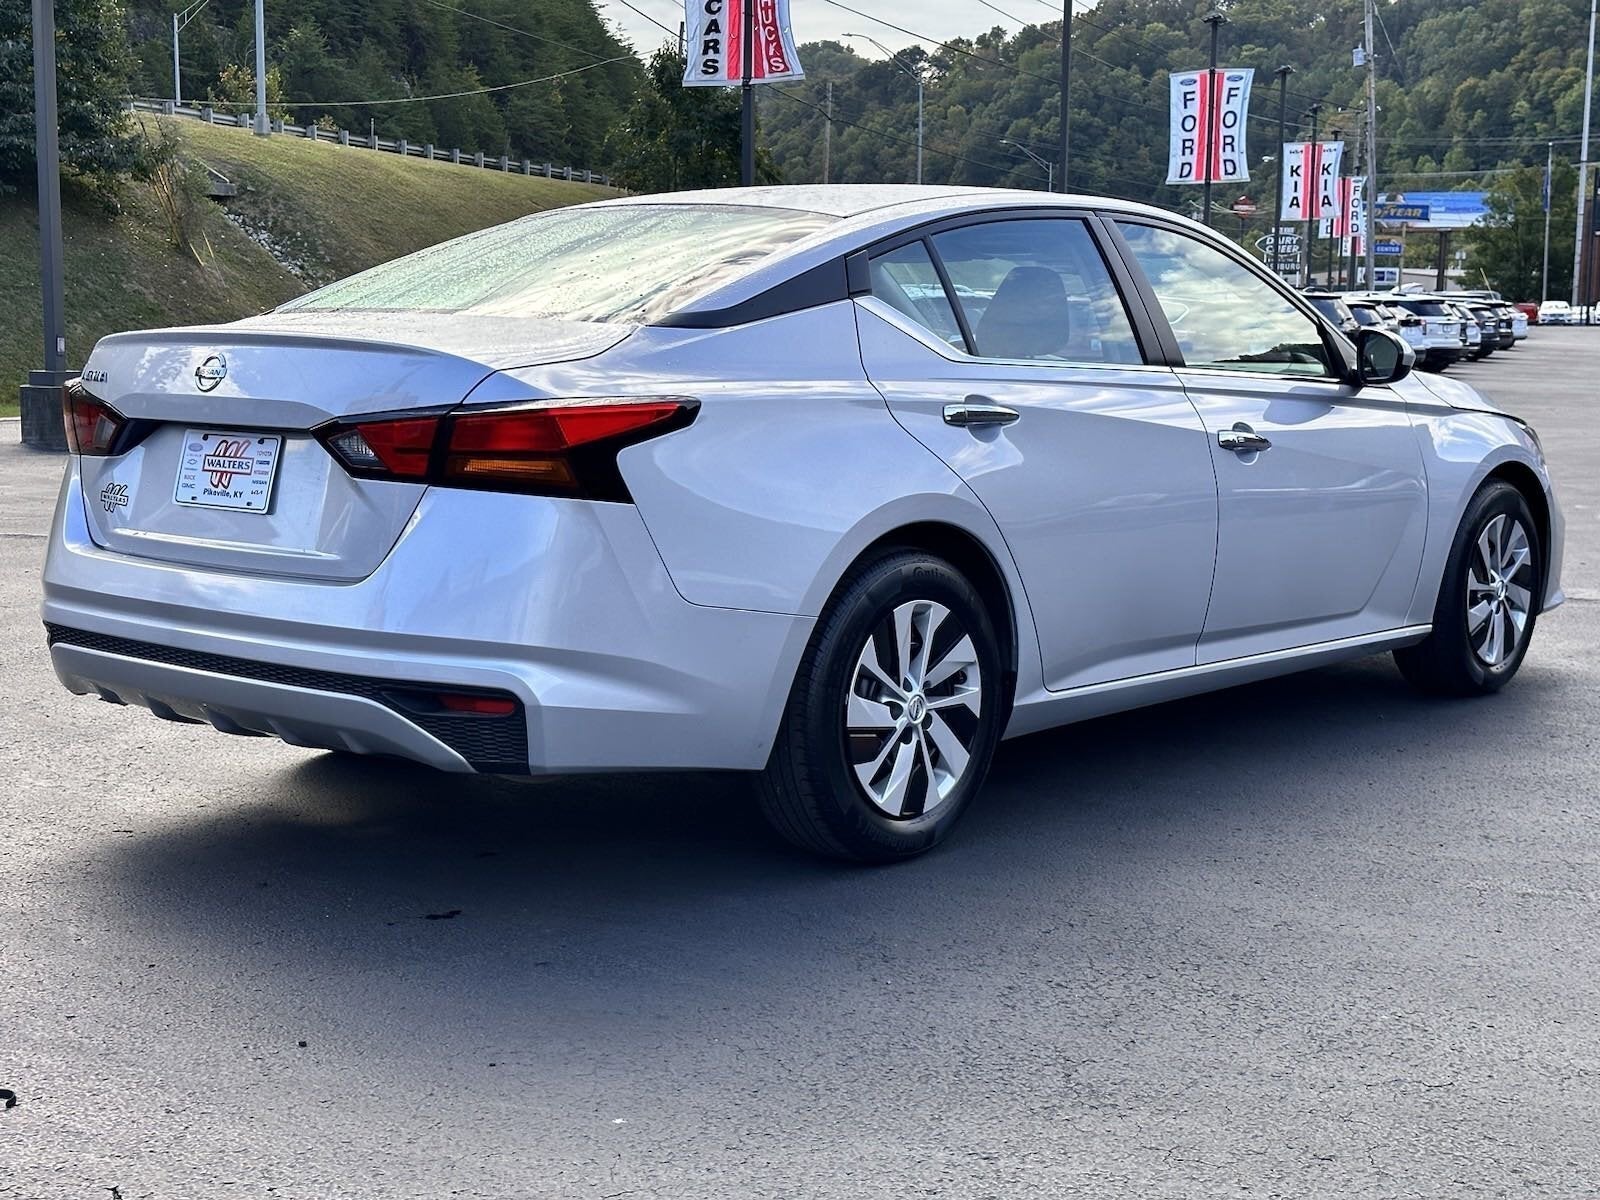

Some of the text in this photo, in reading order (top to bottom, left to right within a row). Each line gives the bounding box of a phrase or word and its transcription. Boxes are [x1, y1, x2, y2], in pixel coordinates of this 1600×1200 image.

[701, 0, 722, 75] CARS
[1179, 91, 1197, 178] FORD
[1222, 87, 1240, 176] FORD
[1289, 165, 1302, 208] KIA
[1321, 163, 1332, 207] KIA
[1351, 185, 1360, 233] FORD
[206, 457, 251, 471] WALTERS
[233, 490, 244, 499] KY
